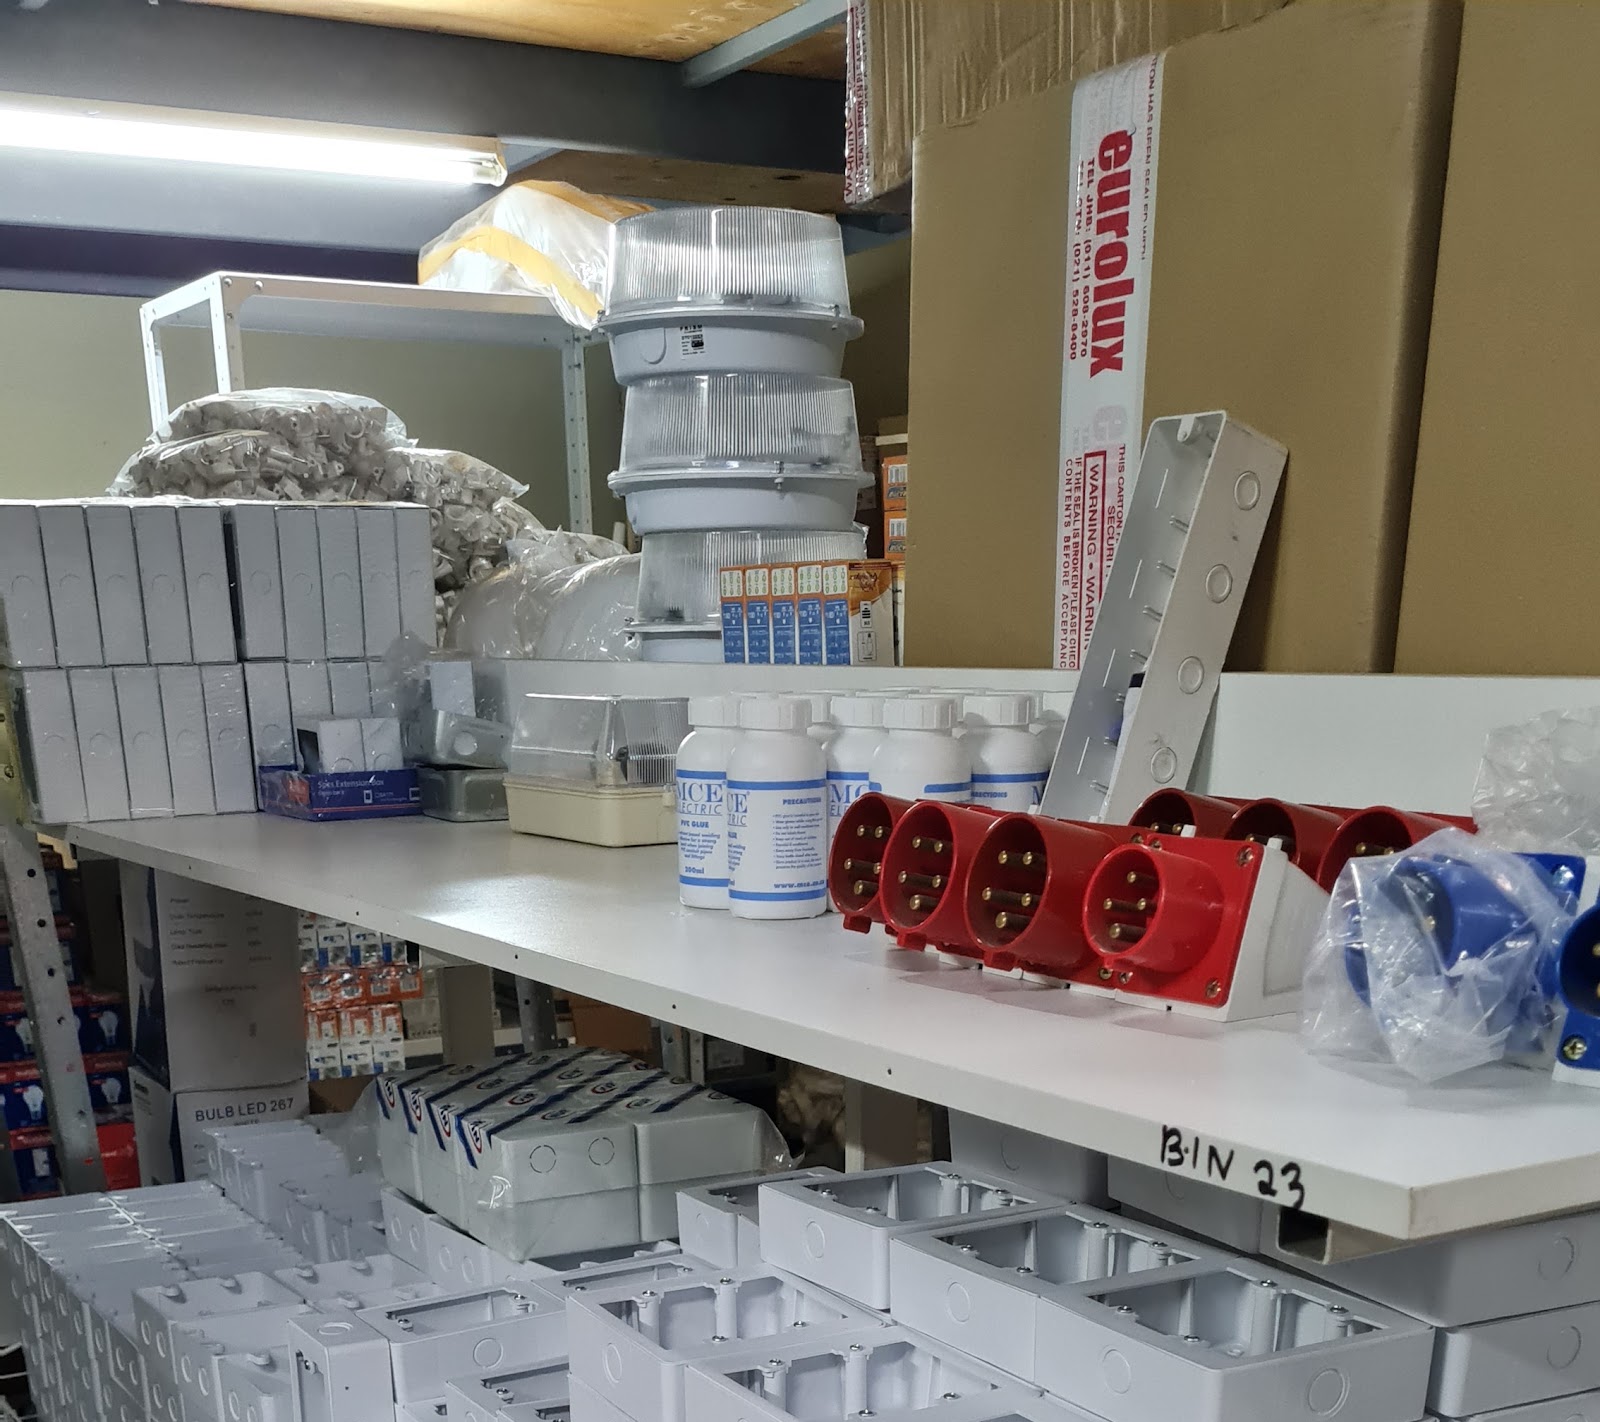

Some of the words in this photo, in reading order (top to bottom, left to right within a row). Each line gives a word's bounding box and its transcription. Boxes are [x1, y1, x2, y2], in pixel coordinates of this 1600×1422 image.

[1086, 157, 1095, 188] TEL
[1071, 243, 1081, 282] (021)
[1082, 239, 1092, 279] (011)
[1090, 129, 1134, 378] eurolux
[1075, 457, 1082, 467] IF
[1118, 443, 1126, 473] THIS
[1063, 459, 1072, 528] CONTENTS
[1074, 470, 1082, 493] THE
[1073, 496, 1081, 526] SEAL
[1087, 463, 1100, 556] WARNING
[1116, 476, 1125, 529] CARTON
[1072, 528, 1080, 539] IS
[1062, 535, 1071, 586] BEFORE
[1071, 541, 1080, 589] BROKEN
[1060, 593, 1069, 668] ACCEPTANC
[1069, 592, 1078, 635] PLEASE
[1068, 638, 1076, 668] CHEC
[336, 779, 370, 788] Extension
[830, 783, 869, 803] MC
[691, 820, 709, 829] GLUE
[195, 1105, 235, 1121] BULB
[238, 1101, 267, 1116] LED
[270, 1097, 294, 1112] 267
[1160, 1124, 1234, 1181] BIN
[1253, 1159, 1305, 1210] 23
